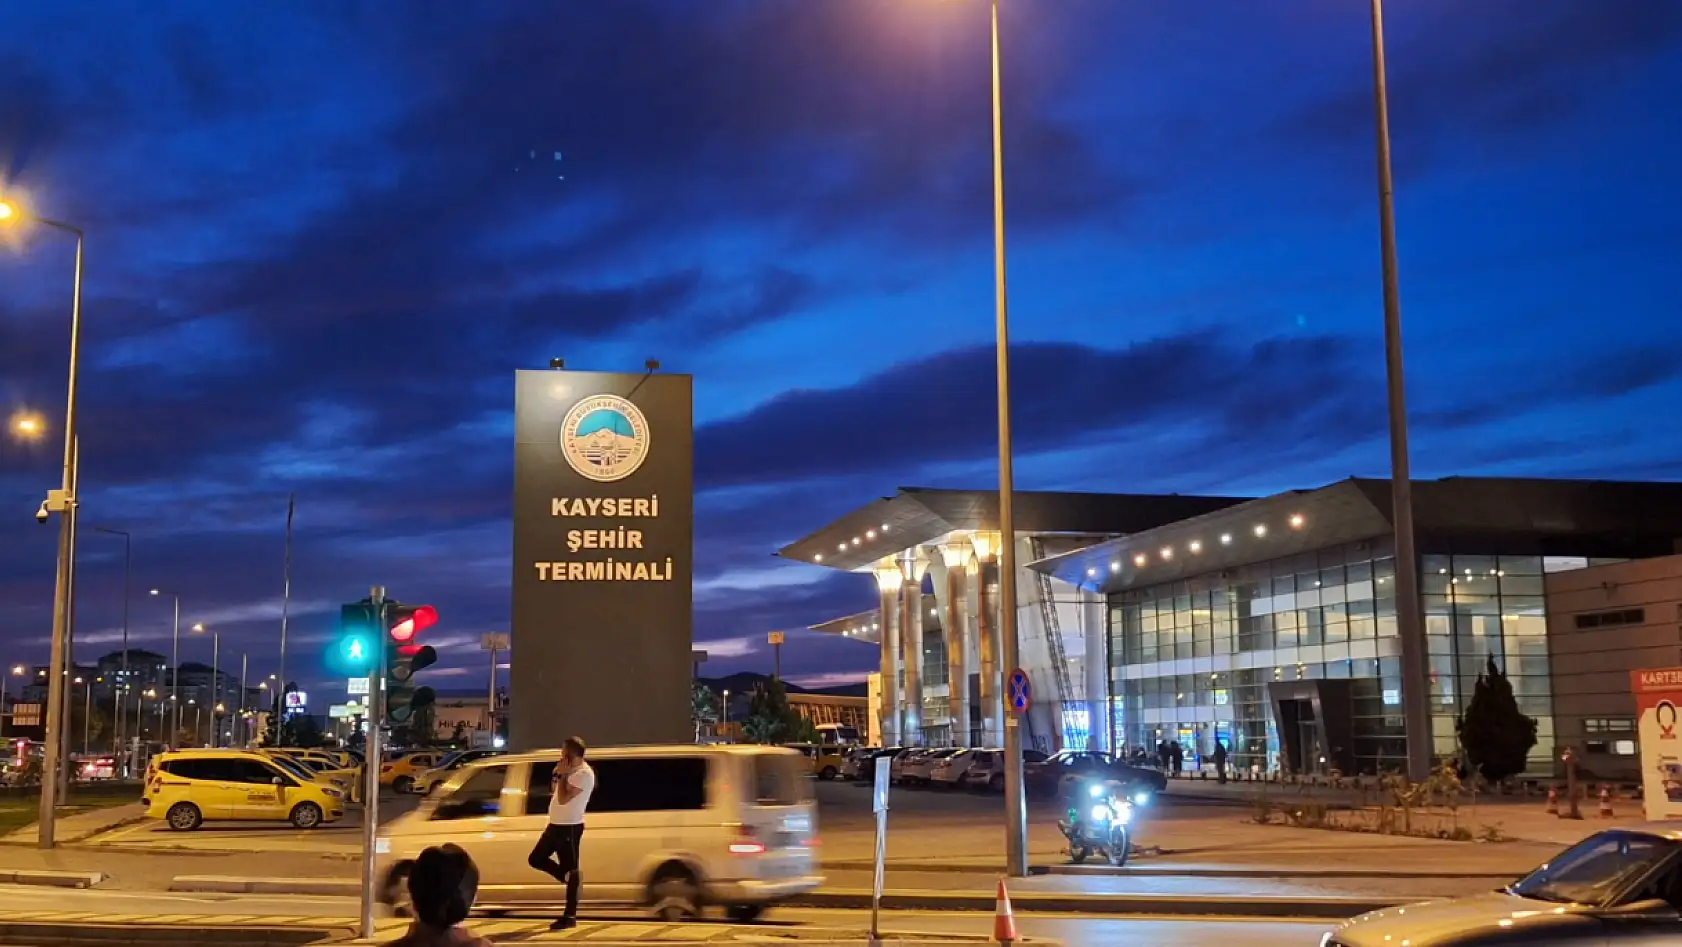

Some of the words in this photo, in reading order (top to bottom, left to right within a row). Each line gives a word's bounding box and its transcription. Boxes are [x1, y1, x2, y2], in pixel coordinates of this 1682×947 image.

[551, 494, 658, 517] KAYSERİ
[567, 525, 643, 552] ŞEHİR
[534, 557, 672, 581] TERMİNALİ
